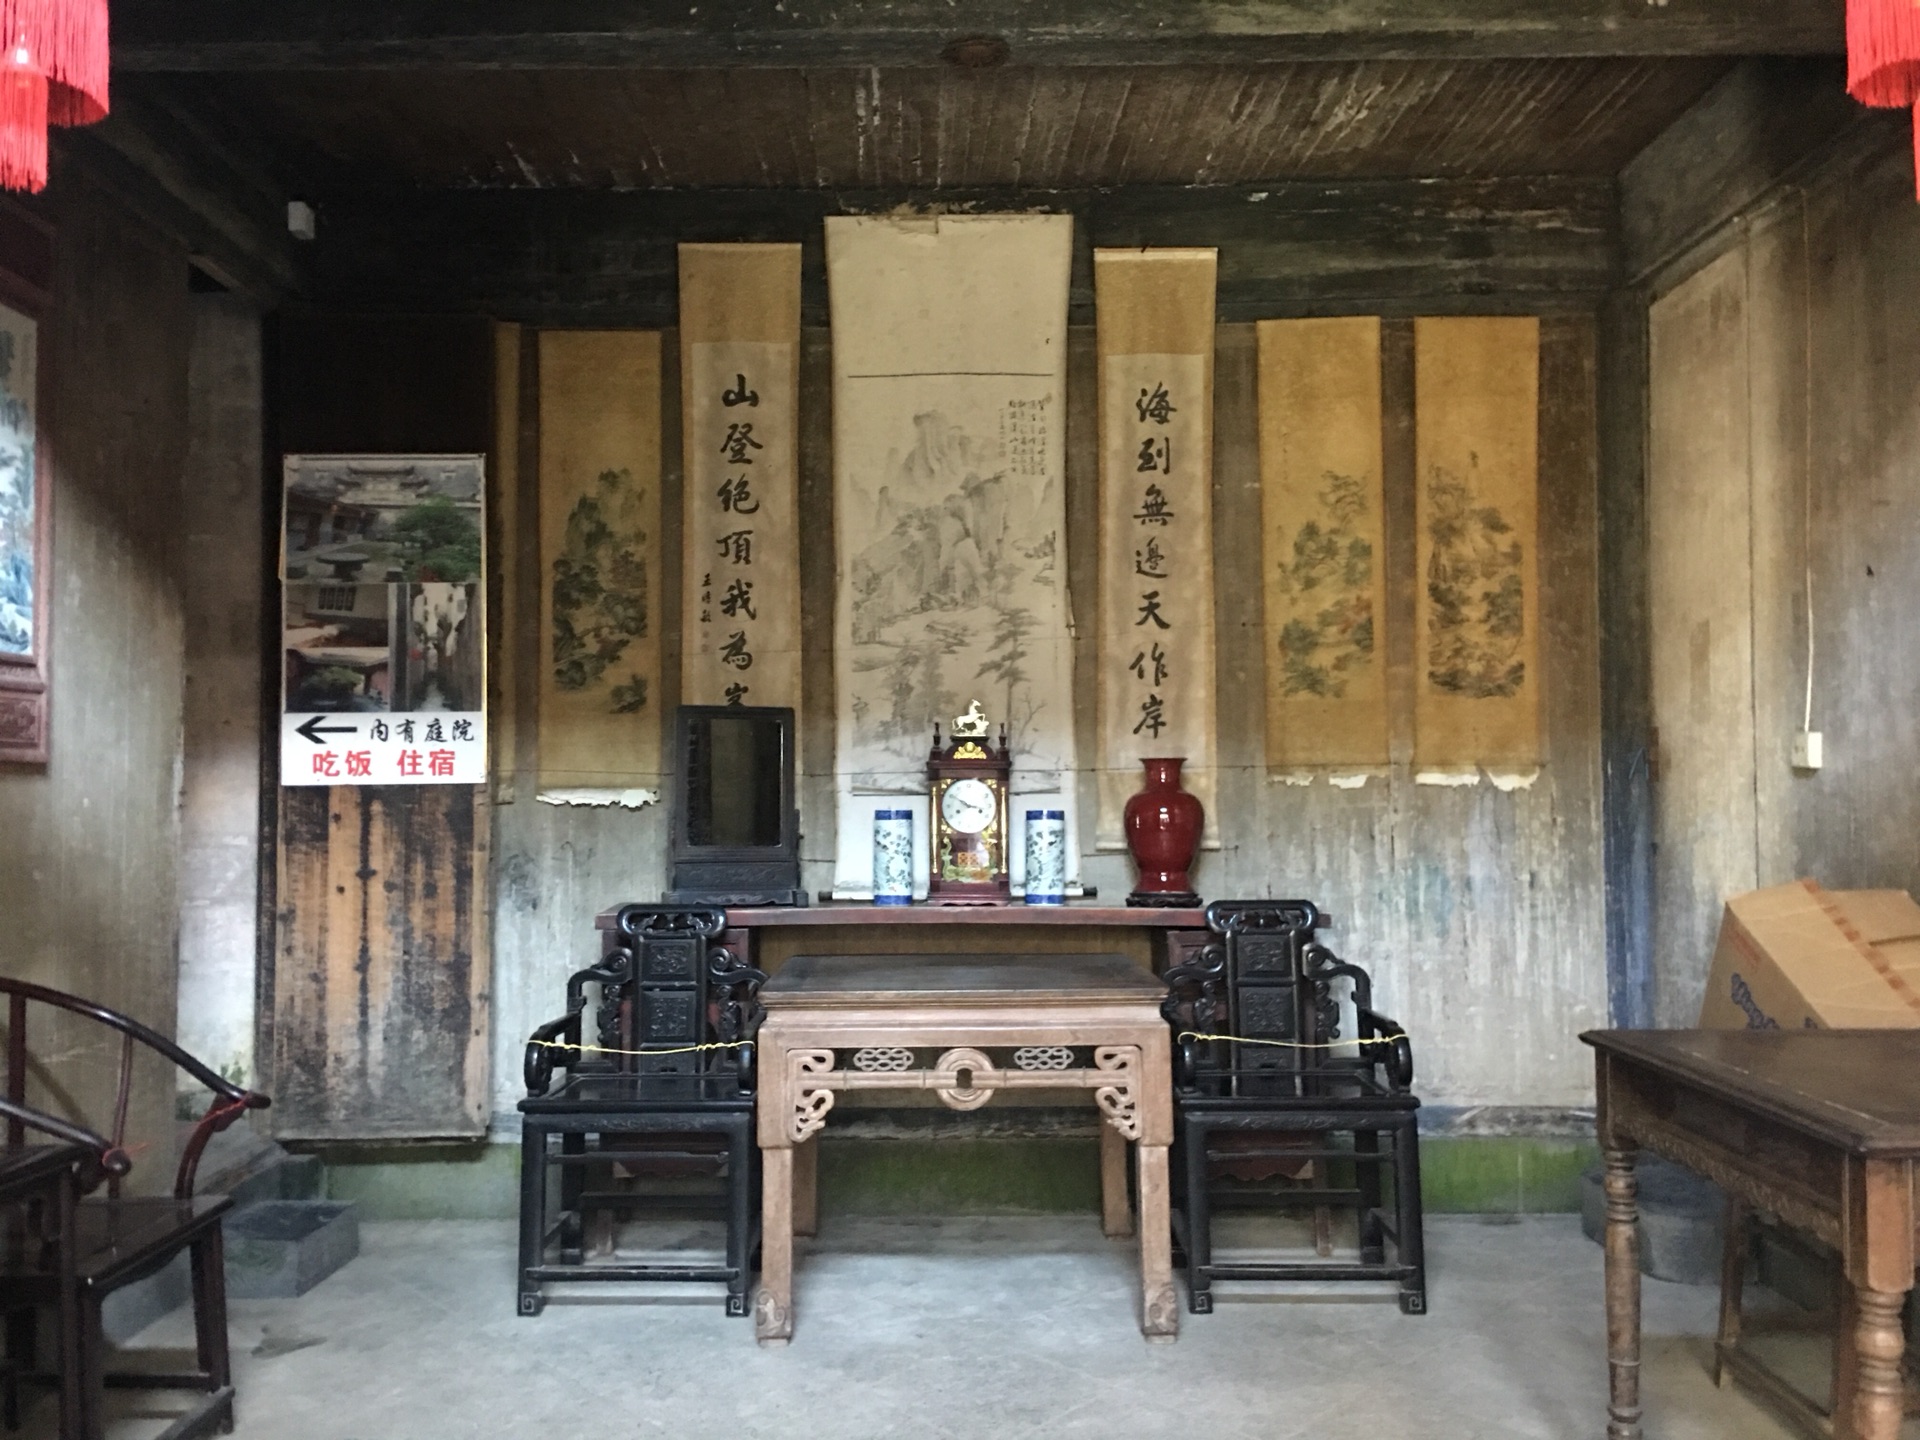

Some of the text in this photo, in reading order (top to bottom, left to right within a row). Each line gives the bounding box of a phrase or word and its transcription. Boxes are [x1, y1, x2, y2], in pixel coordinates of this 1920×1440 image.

[370, 718, 475, 744] 内有庭院
[312, 749, 456, 777] 吃饭 住宿
